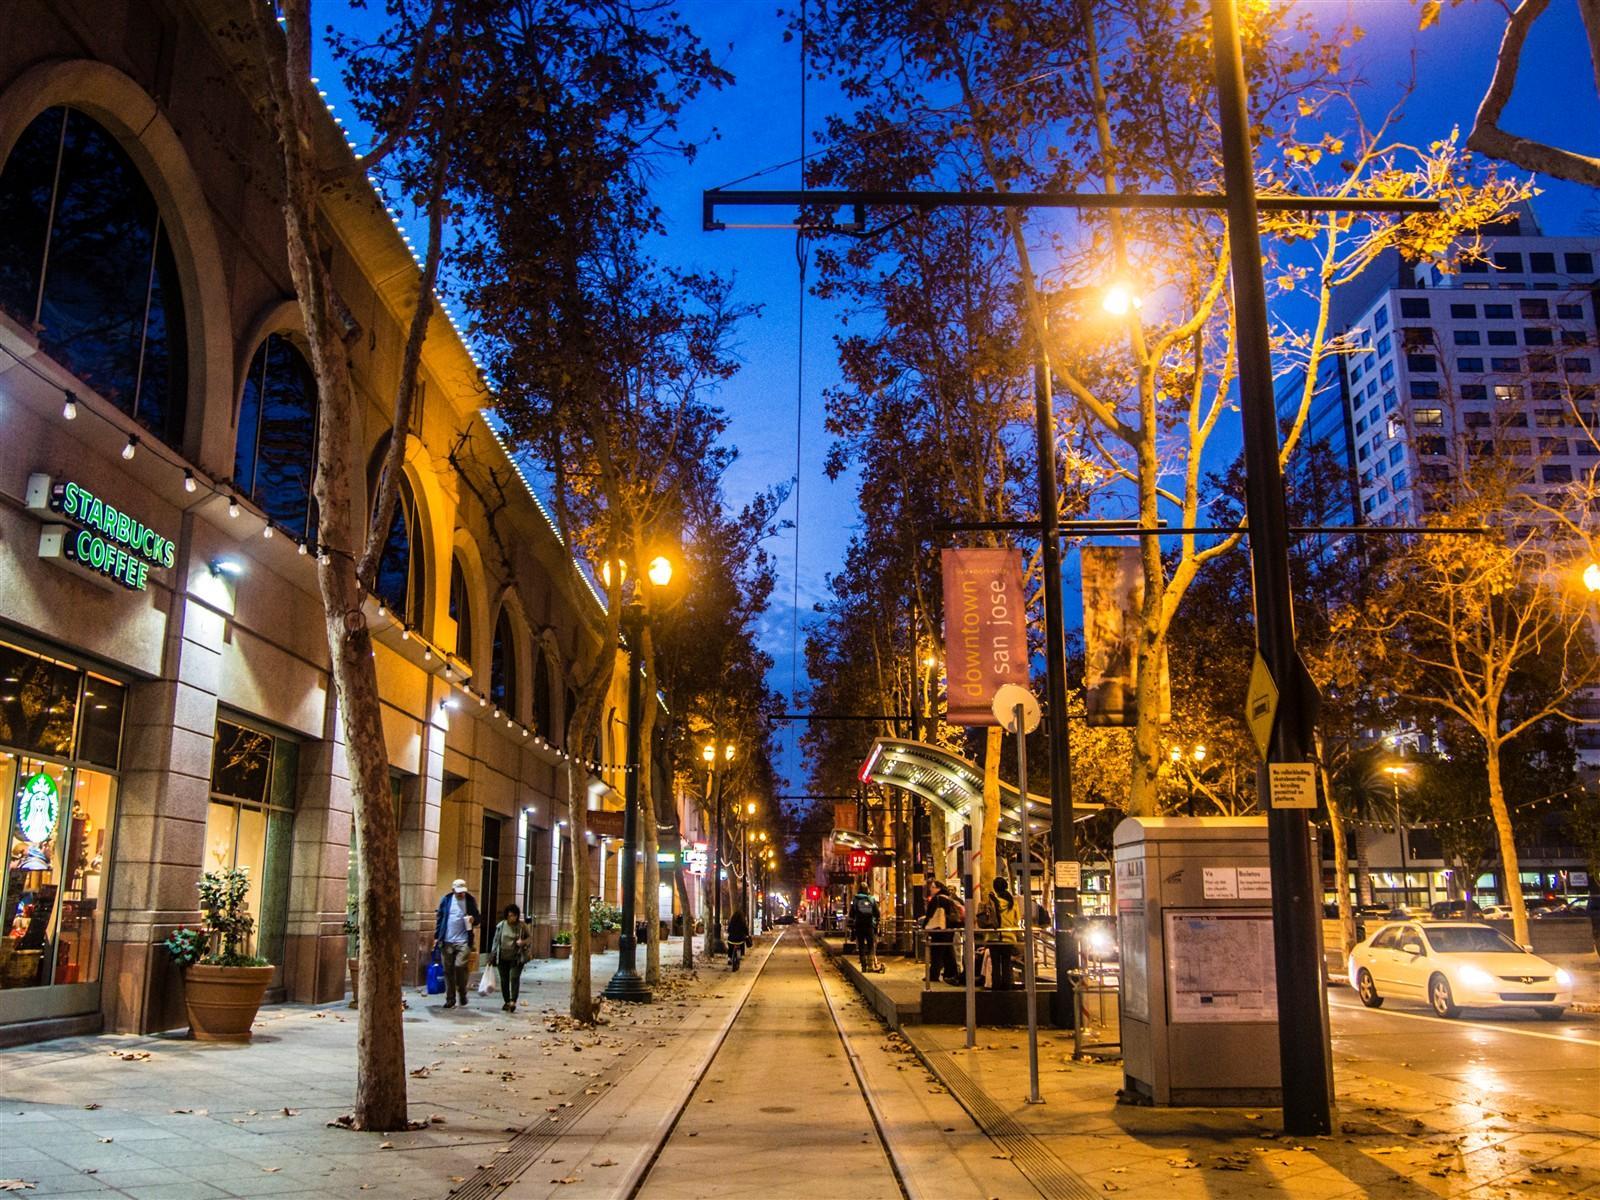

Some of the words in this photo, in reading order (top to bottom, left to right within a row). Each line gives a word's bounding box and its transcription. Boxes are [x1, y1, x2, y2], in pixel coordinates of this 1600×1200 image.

[64, 481, 175, 568] STARBUCKS
[77, 530, 149, 591] COFFEE
[987, 580, 1013, 626] jose
[961, 581, 983, 697] downtown
[994, 637, 1010, 675] san
